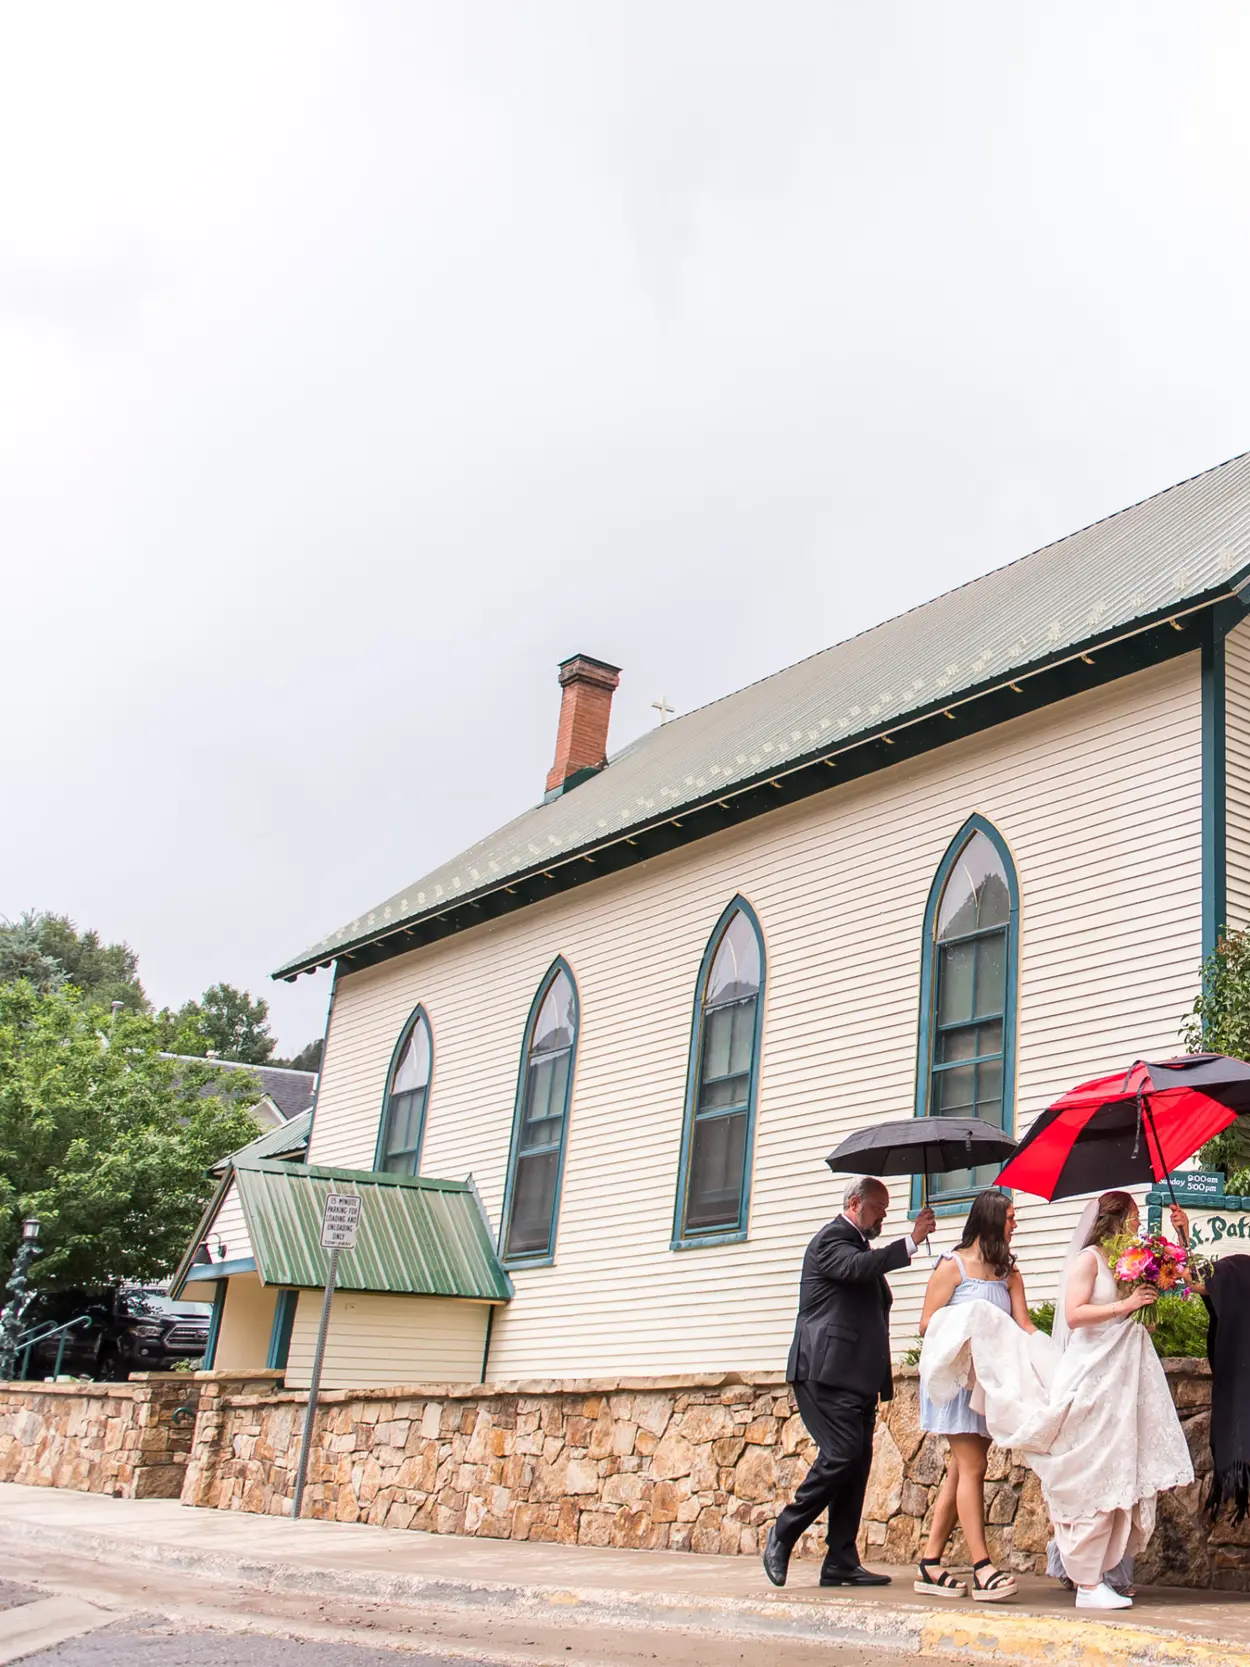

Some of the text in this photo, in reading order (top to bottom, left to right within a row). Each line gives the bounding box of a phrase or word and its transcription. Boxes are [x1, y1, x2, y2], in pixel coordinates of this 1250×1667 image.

[1187, 1174, 1218, 1184] 9:00am
[1187, 1182, 1217, 1193] 5:00pm
[339, 1198, 357, 1206] MINUTE
[328, 1206, 357, 1215] PARKING FOR
[326, 1215, 346, 1223] LOADING
[327, 1223, 353, 1232] UNLOADING
